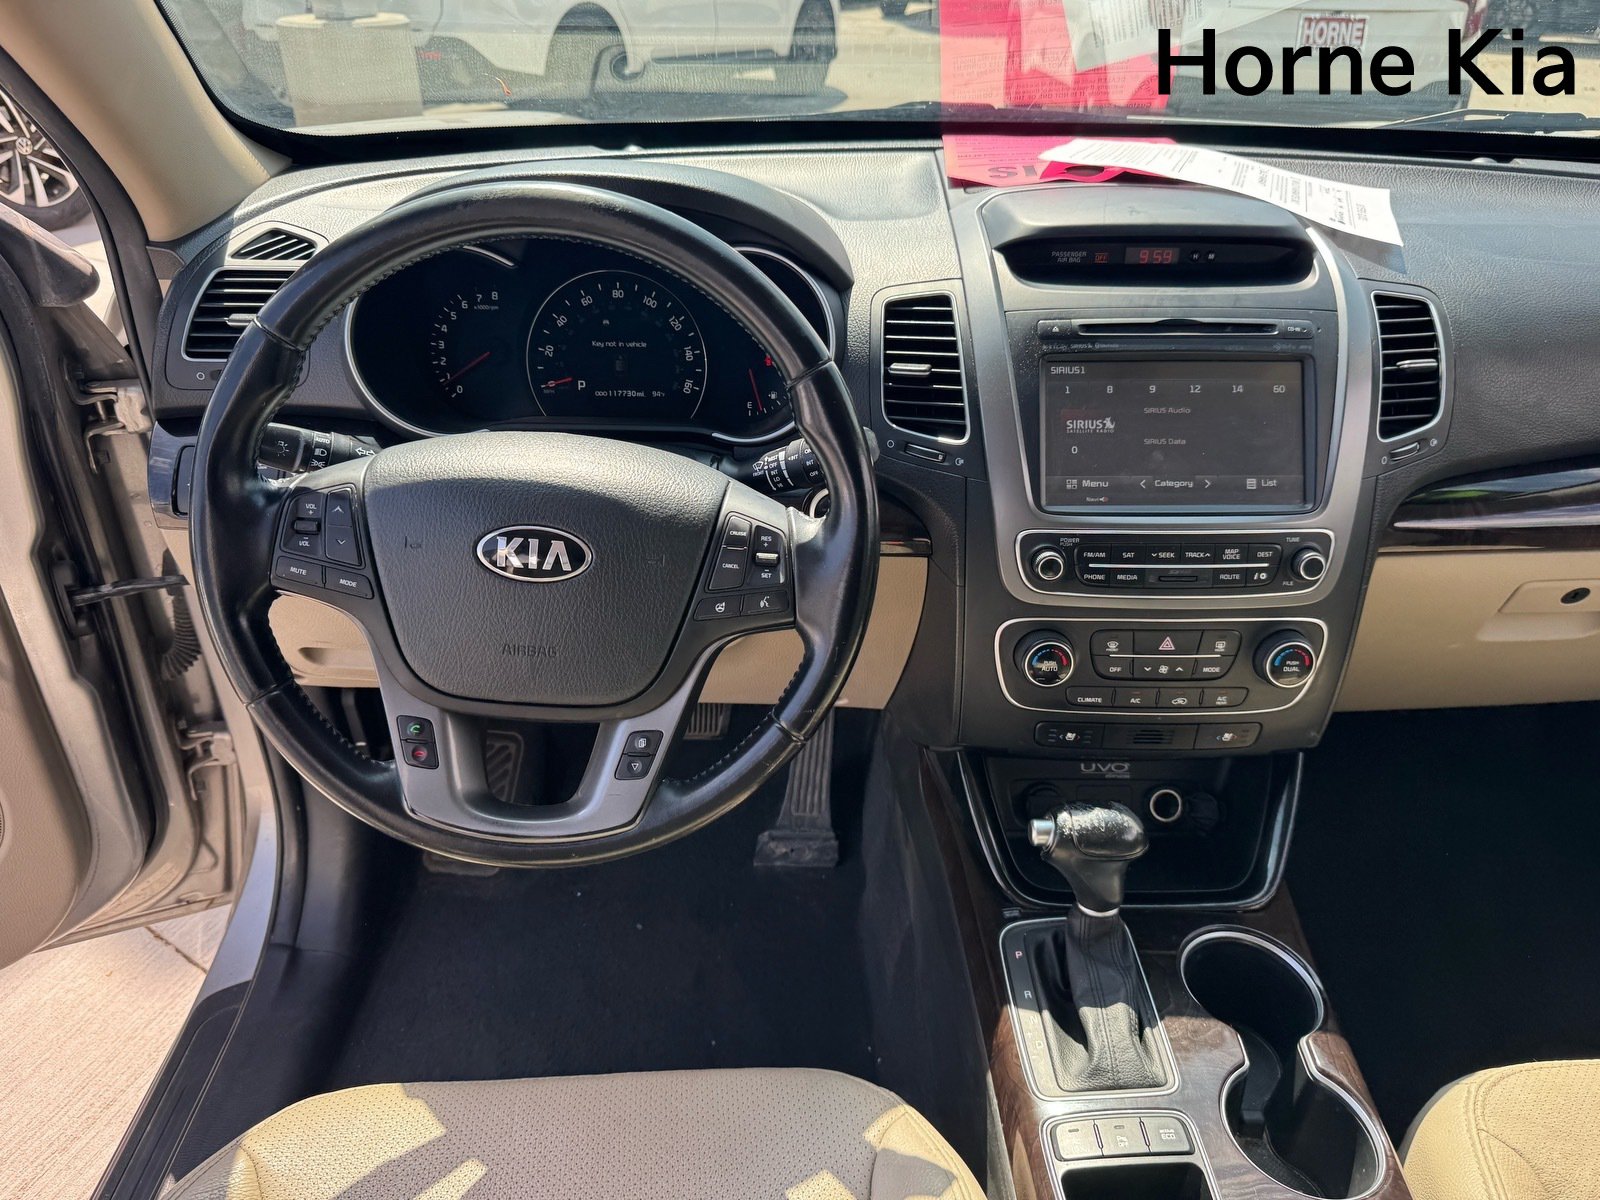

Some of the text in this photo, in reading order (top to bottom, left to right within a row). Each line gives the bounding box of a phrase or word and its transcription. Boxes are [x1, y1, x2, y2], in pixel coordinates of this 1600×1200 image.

[1304, 20, 1364, 46] HORNE
[476, 294, 482, 302] 7
[491, 292, 498, 300] 8
[612, 290, 624, 298] 80
[461, 301, 468, 309] 6
[580, 296, 593, 306] 60
[643, 296, 658, 309] 100
[450, 312, 456, 320] 5
[556, 315, 568, 327] 40
[668, 315, 682, 331] 120
[441, 324, 448, 333] 4
[438, 340, 444, 349] 3
[545, 345, 554, 357] 20
[684, 346, 693, 361] 140
[440, 357, 447, 365] 2
[457, 385, 463, 393] 0
[578, 380, 586, 390] P
[683, 380, 693, 394] 160
[1066, 420, 1103, 429] SIRIUS
[1082, 480, 1109, 488] Menu
[1154, 480, 1194, 488] Category
[497, 536, 572, 571] KIA
[290, 566, 307, 576] MUTE
[339, 578, 357, 588] MODE
[502, 643, 557, 657] AIRBAG
[1081, 763, 1129, 772] UVO
[1015, 951, 1023, 959] P
[1024, 990, 1032, 998] R
